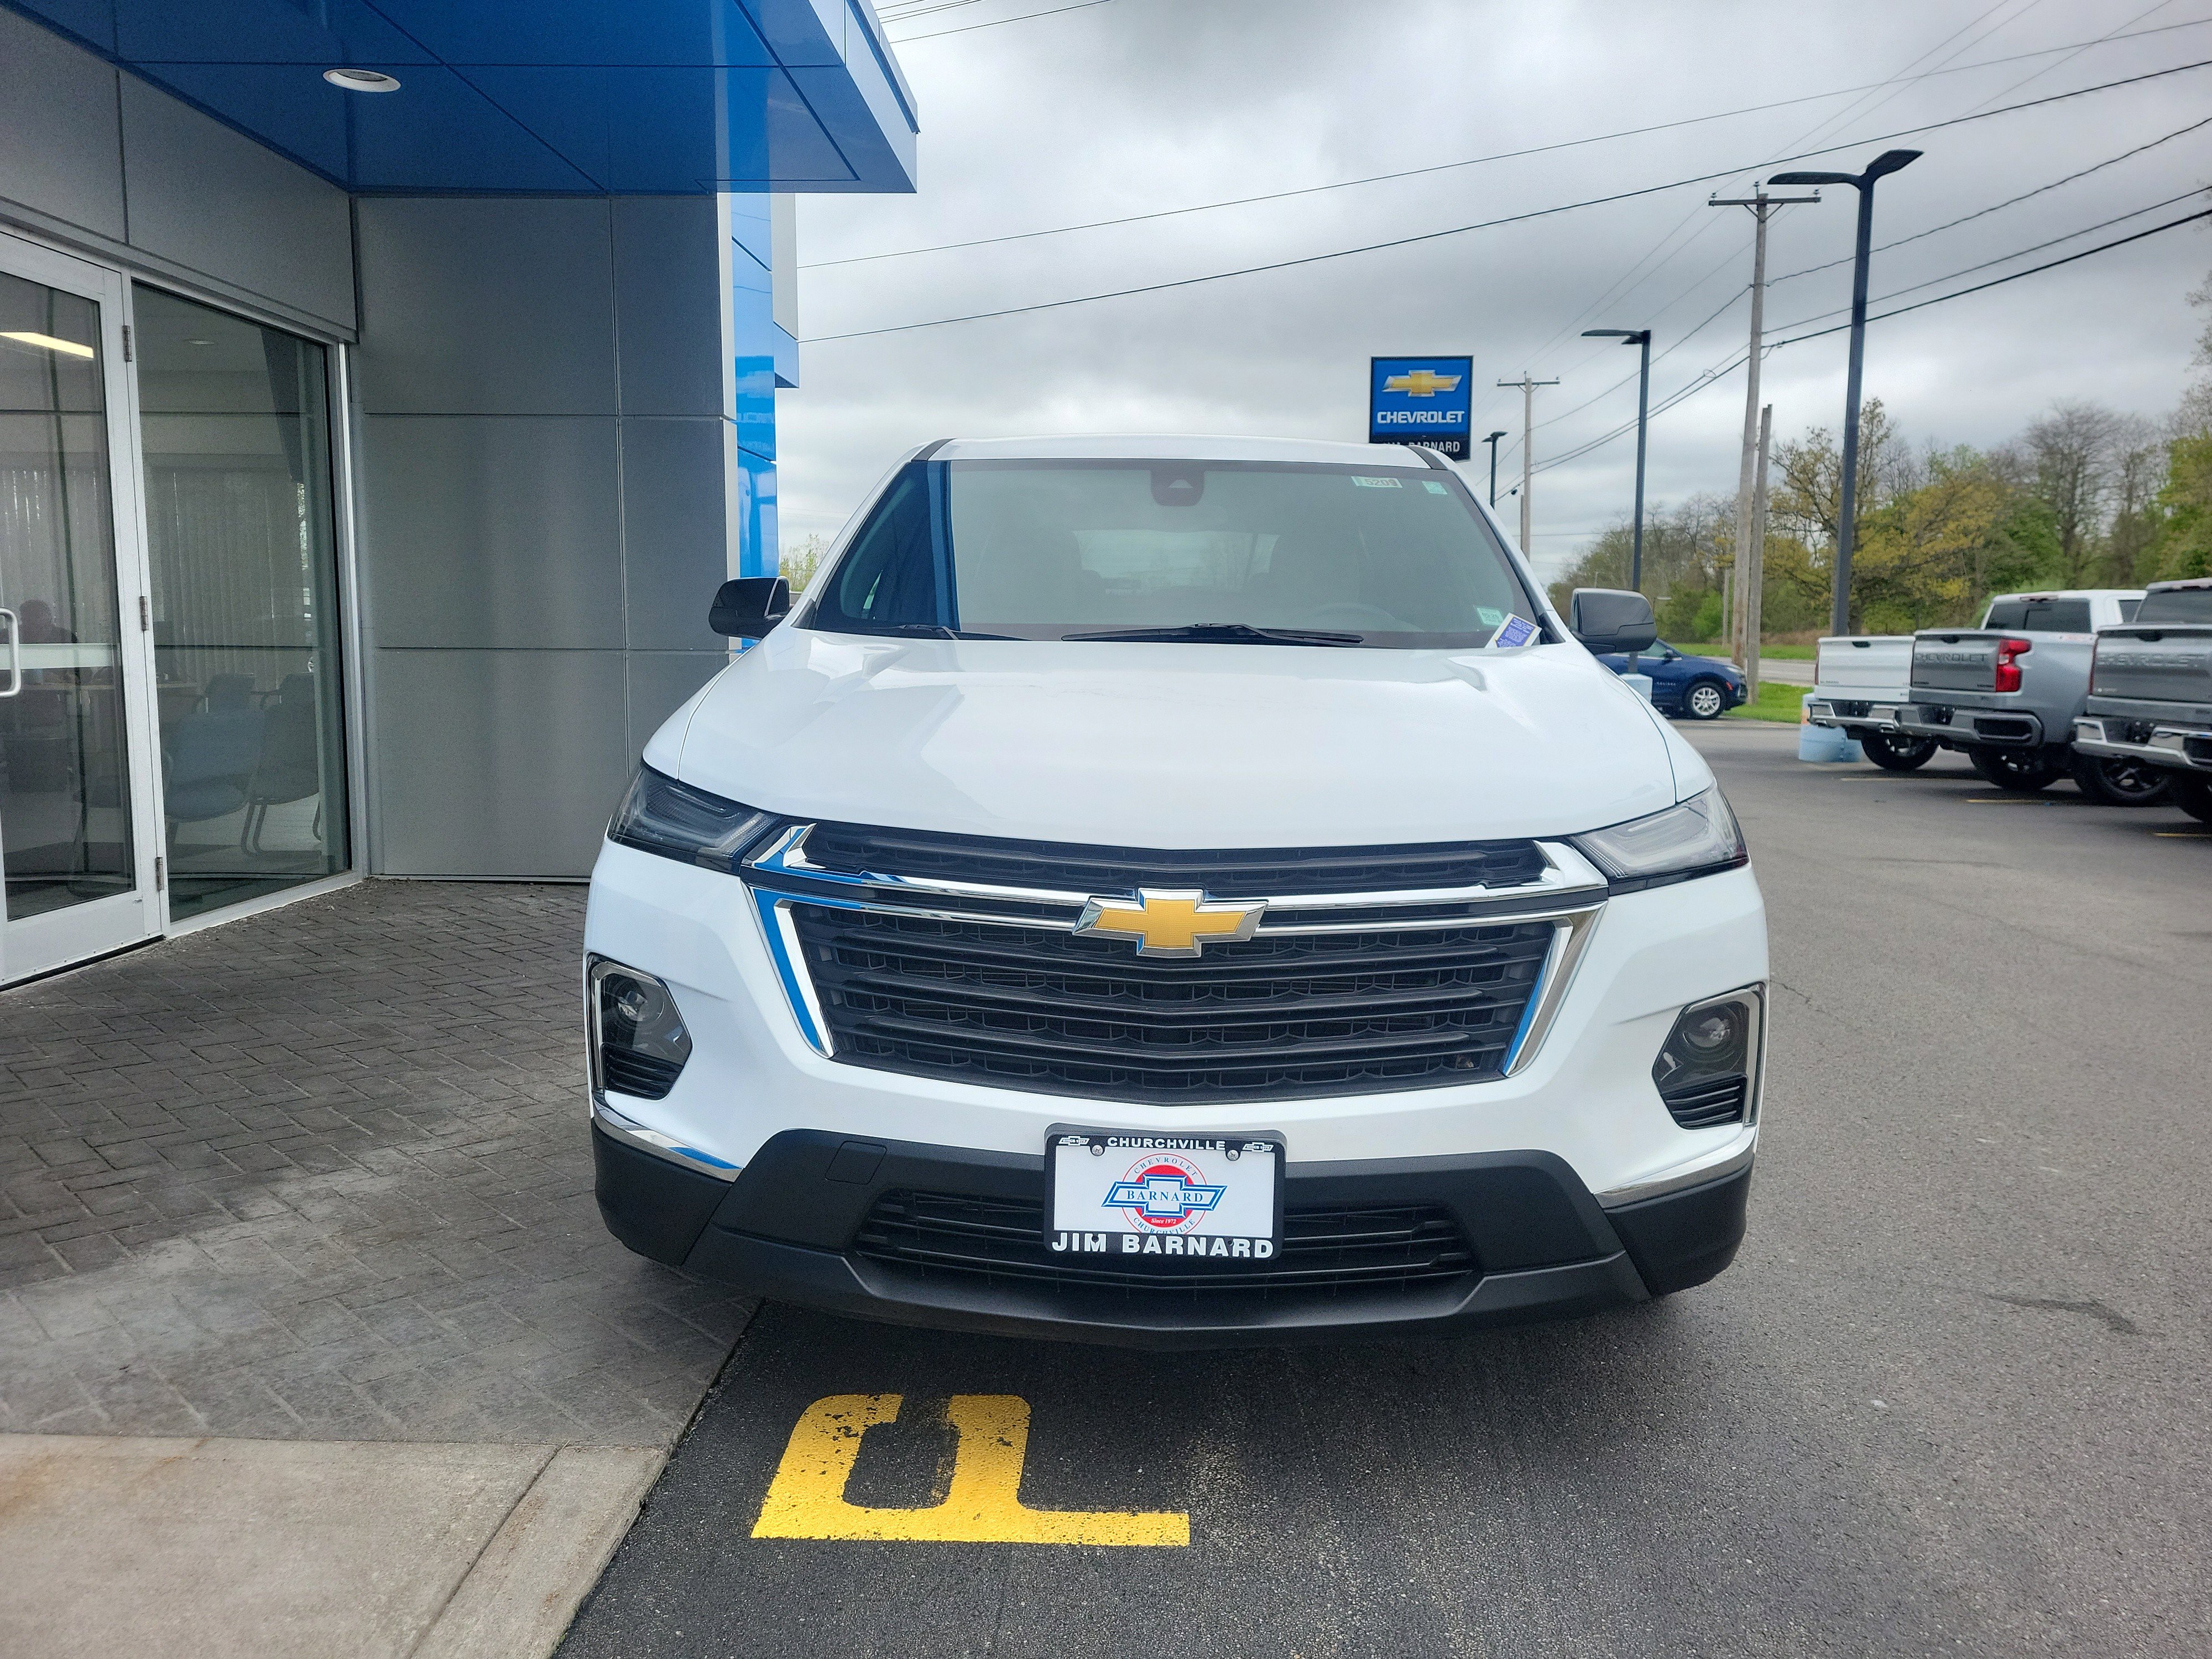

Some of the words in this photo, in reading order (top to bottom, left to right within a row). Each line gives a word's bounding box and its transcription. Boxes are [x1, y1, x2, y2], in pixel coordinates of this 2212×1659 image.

[1377, 411, 1465, 424] CHEVROLET
[1107, 1137, 1225, 1150] CHURCHVILLE
[1134, 1157, 1198, 1176] CHEVROLET
[1126, 1190, 1203, 1202] BARNARD
[1052, 1233, 1107, 1253] JIM
[1123, 1235, 1273, 1259] BARNARD
